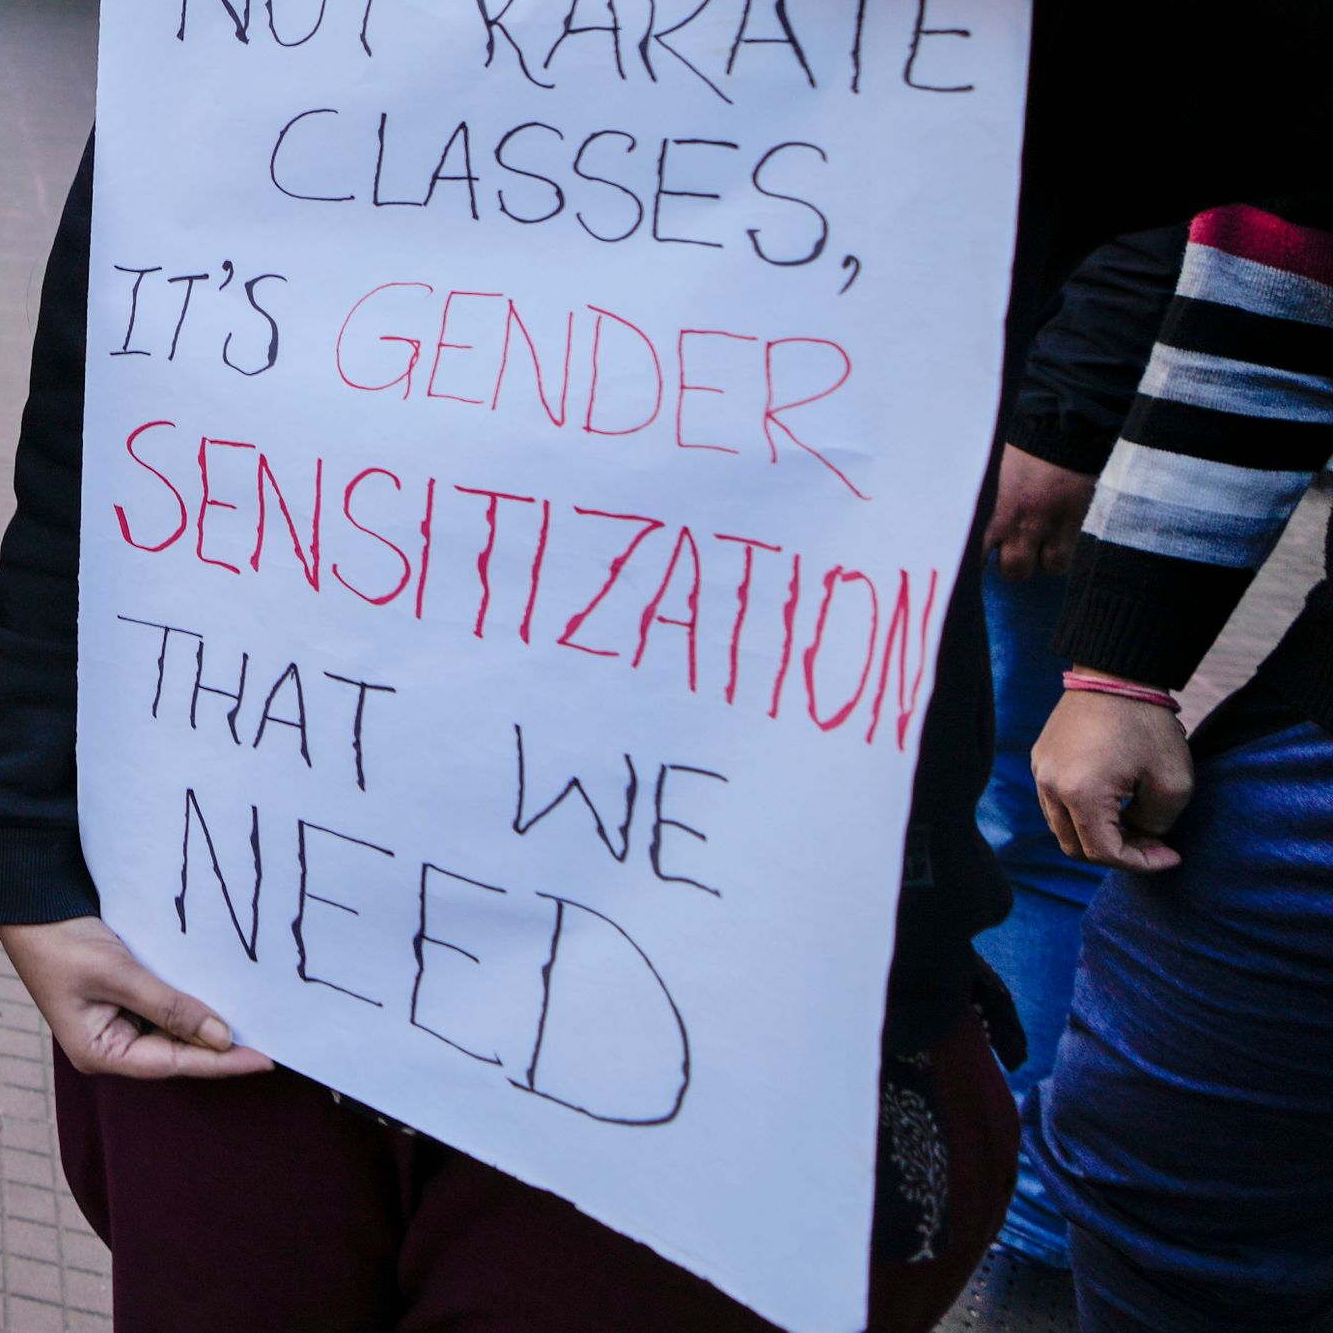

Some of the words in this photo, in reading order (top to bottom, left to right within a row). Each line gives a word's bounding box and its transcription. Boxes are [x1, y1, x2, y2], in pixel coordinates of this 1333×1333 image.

[270, 109, 860, 294] CLASSES,
[110, 260, 287, 376] IT'S
[336, 281, 871, 501] GENDER
[114, 420, 937, 751] SENSITIZATION
[117, 615, 396, 791] THAT
[513, 724, 727, 897] WE
[175, 788, 690, 1125] NEED
